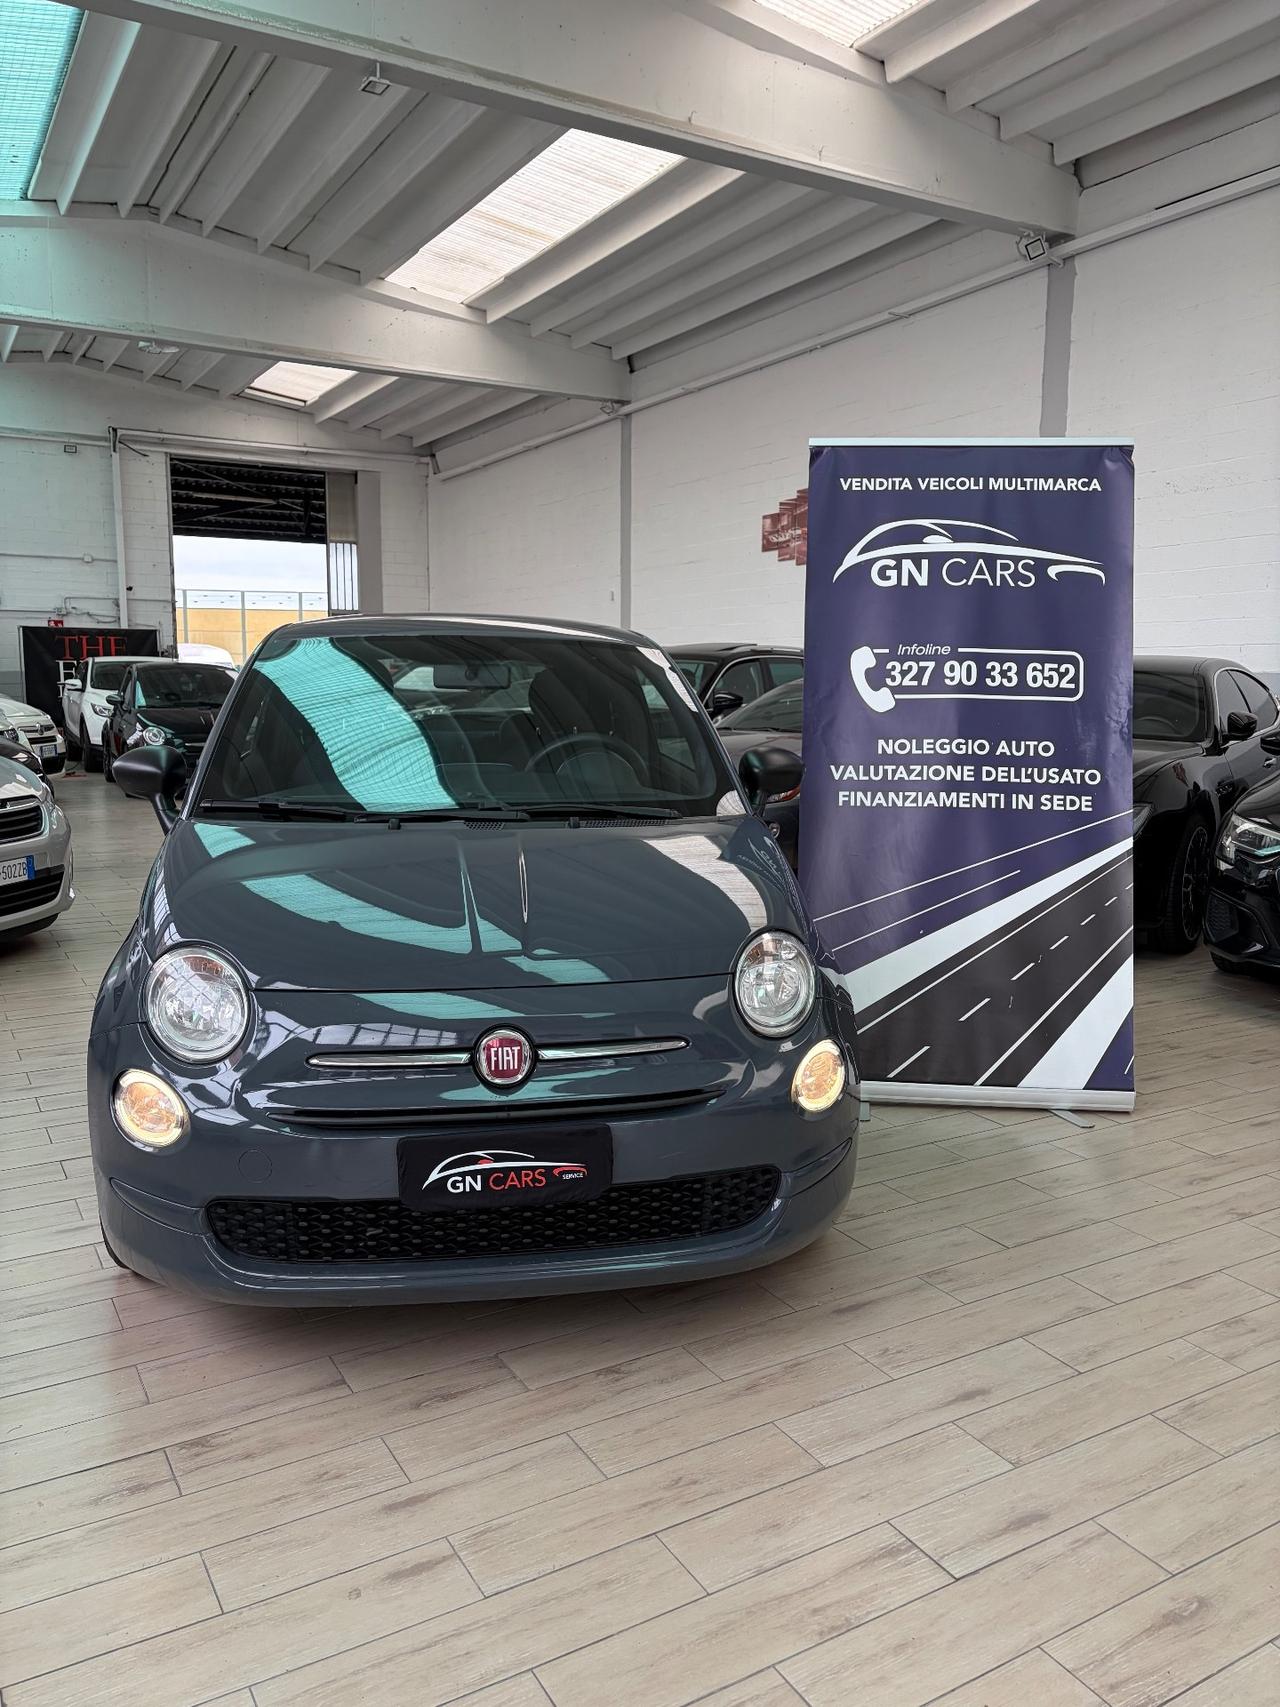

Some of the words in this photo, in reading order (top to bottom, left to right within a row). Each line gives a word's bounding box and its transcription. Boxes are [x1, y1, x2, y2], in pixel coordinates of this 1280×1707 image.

[840, 477, 912, 491] VENDITA
[917, 477, 983, 491] VEICOLI
[988, 477, 1102, 492] MULTIMARCA
[870, 558, 929, 587] GN
[942, 558, 1036, 588] CARS
[55, 634, 127, 659] THE
[897, 643, 951, 656] Infoline
[885, 660, 936, 687] 327
[943, 660, 977, 687] 90
[985, 662, 1018, 688] 33
[1025, 662, 1076, 690] 652
[877, 738, 990, 755] NOLEGGIO
[996, 740, 1055, 757] AUTO
[830, 764, 975, 782] VALUTAZIONE
[838, 791, 1006, 809] FINANZIAMENTI
[1011, 794, 1034, 810] IN
[1040, 794, 1093, 812] SEDE
[0, 861, 27, 881] 502ZB
[489, 1046, 521, 1072] FIAT
[446, 1174, 482, 1194] GN
[489, 1168, 547, 1191] CARS
[562, 1172, 584, 1180] SERVICE
